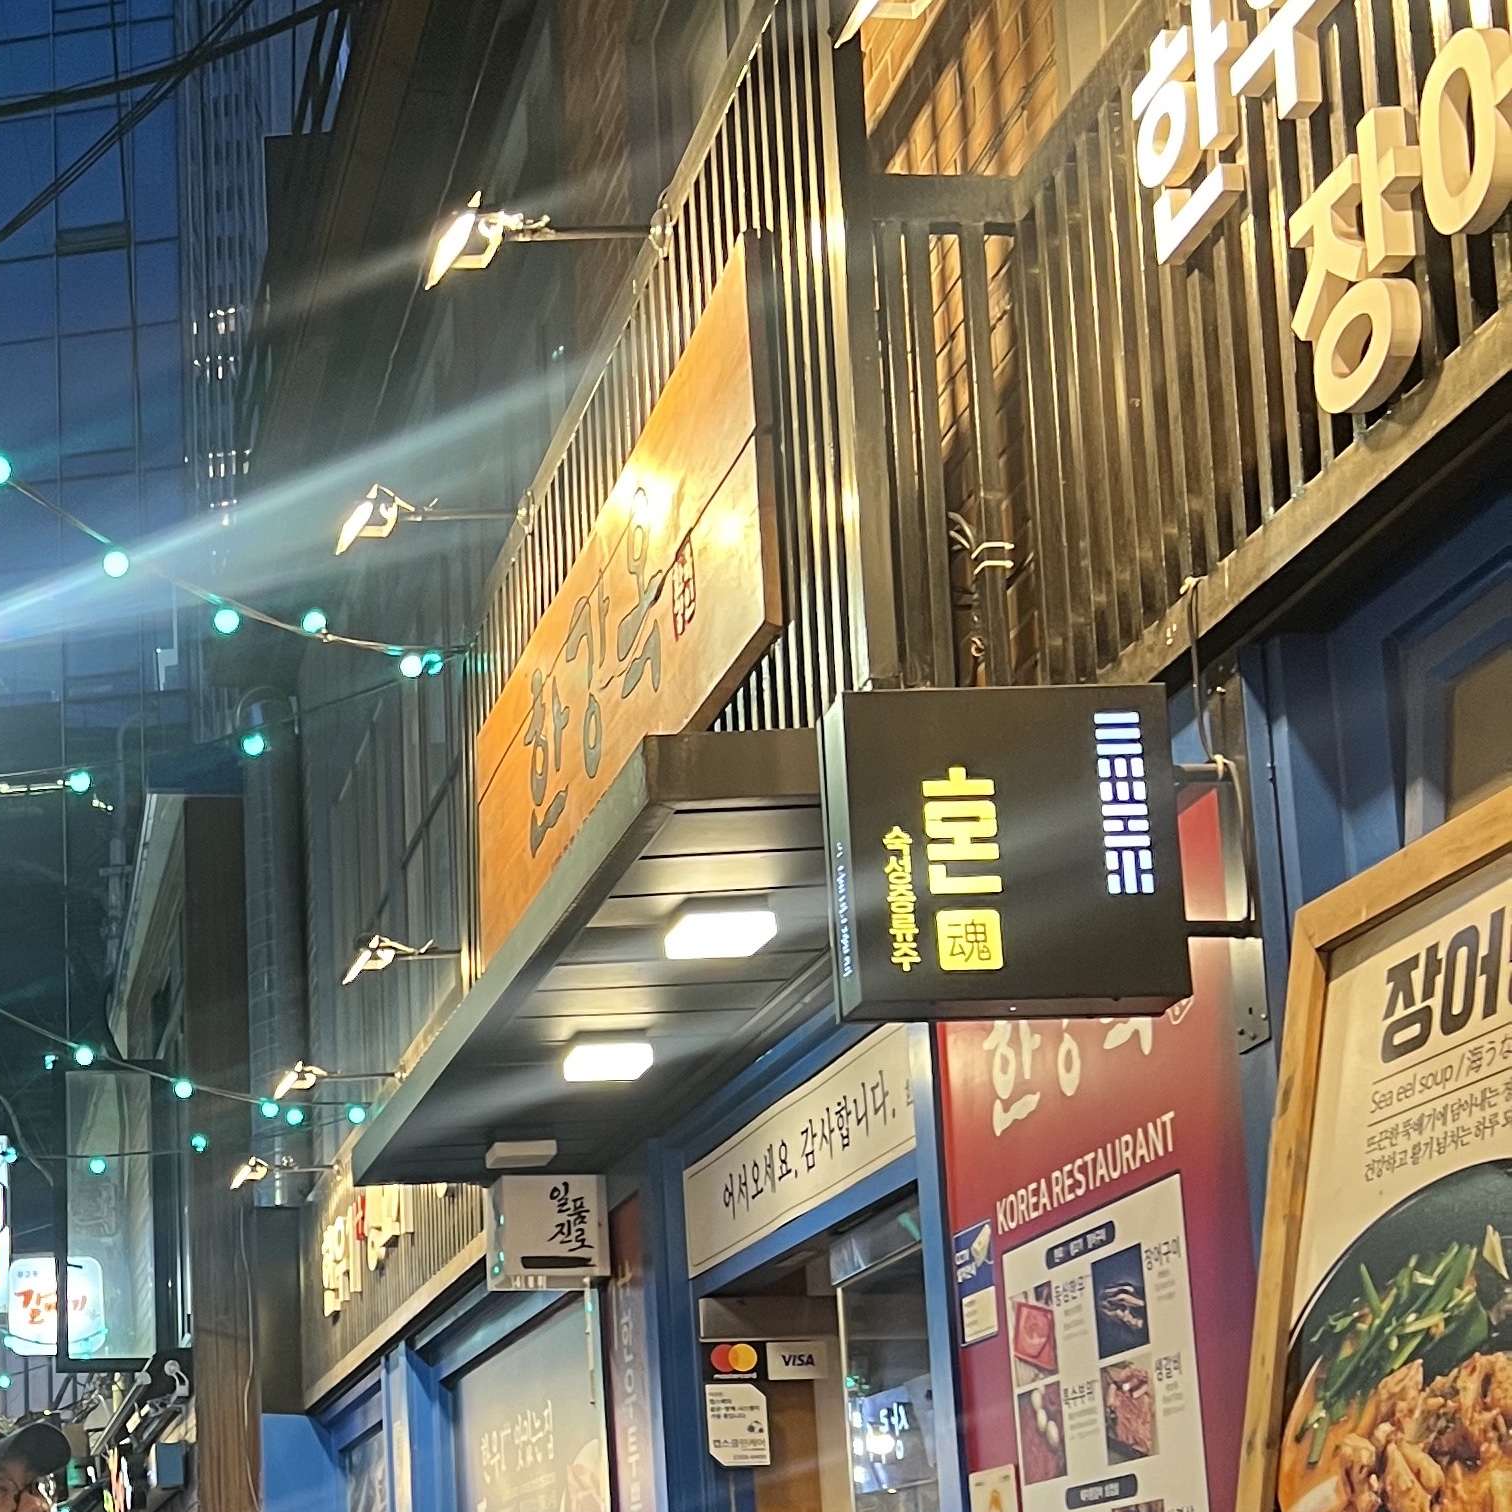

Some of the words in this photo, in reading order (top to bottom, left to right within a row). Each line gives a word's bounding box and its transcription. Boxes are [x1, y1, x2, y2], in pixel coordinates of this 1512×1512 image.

[922, 767, 1003, 895] 혼
[882, 826, 922, 972] 숙성증류주
[946, 919, 992, 963] 魂
[1381, 906, 1512, 1063] 장어
[1370, 1090, 1394, 1114] Sea
[1396, 1073, 1418, 1102] eel
[1418, 1064, 1454, 1093] soup
[722, 1138, 798, 1221] 어서오세요,
[800, 1069, 896, 1174] 감사합니다.
[995, 1177, 1052, 1235] KOREA
[1051, 1110, 1176, 1208] RESTAURANT
[546, 1219, 595, 1253] 진로
[549, 1181, 591, 1227] 일품
[781, 1354, 816, 1367] VISA
